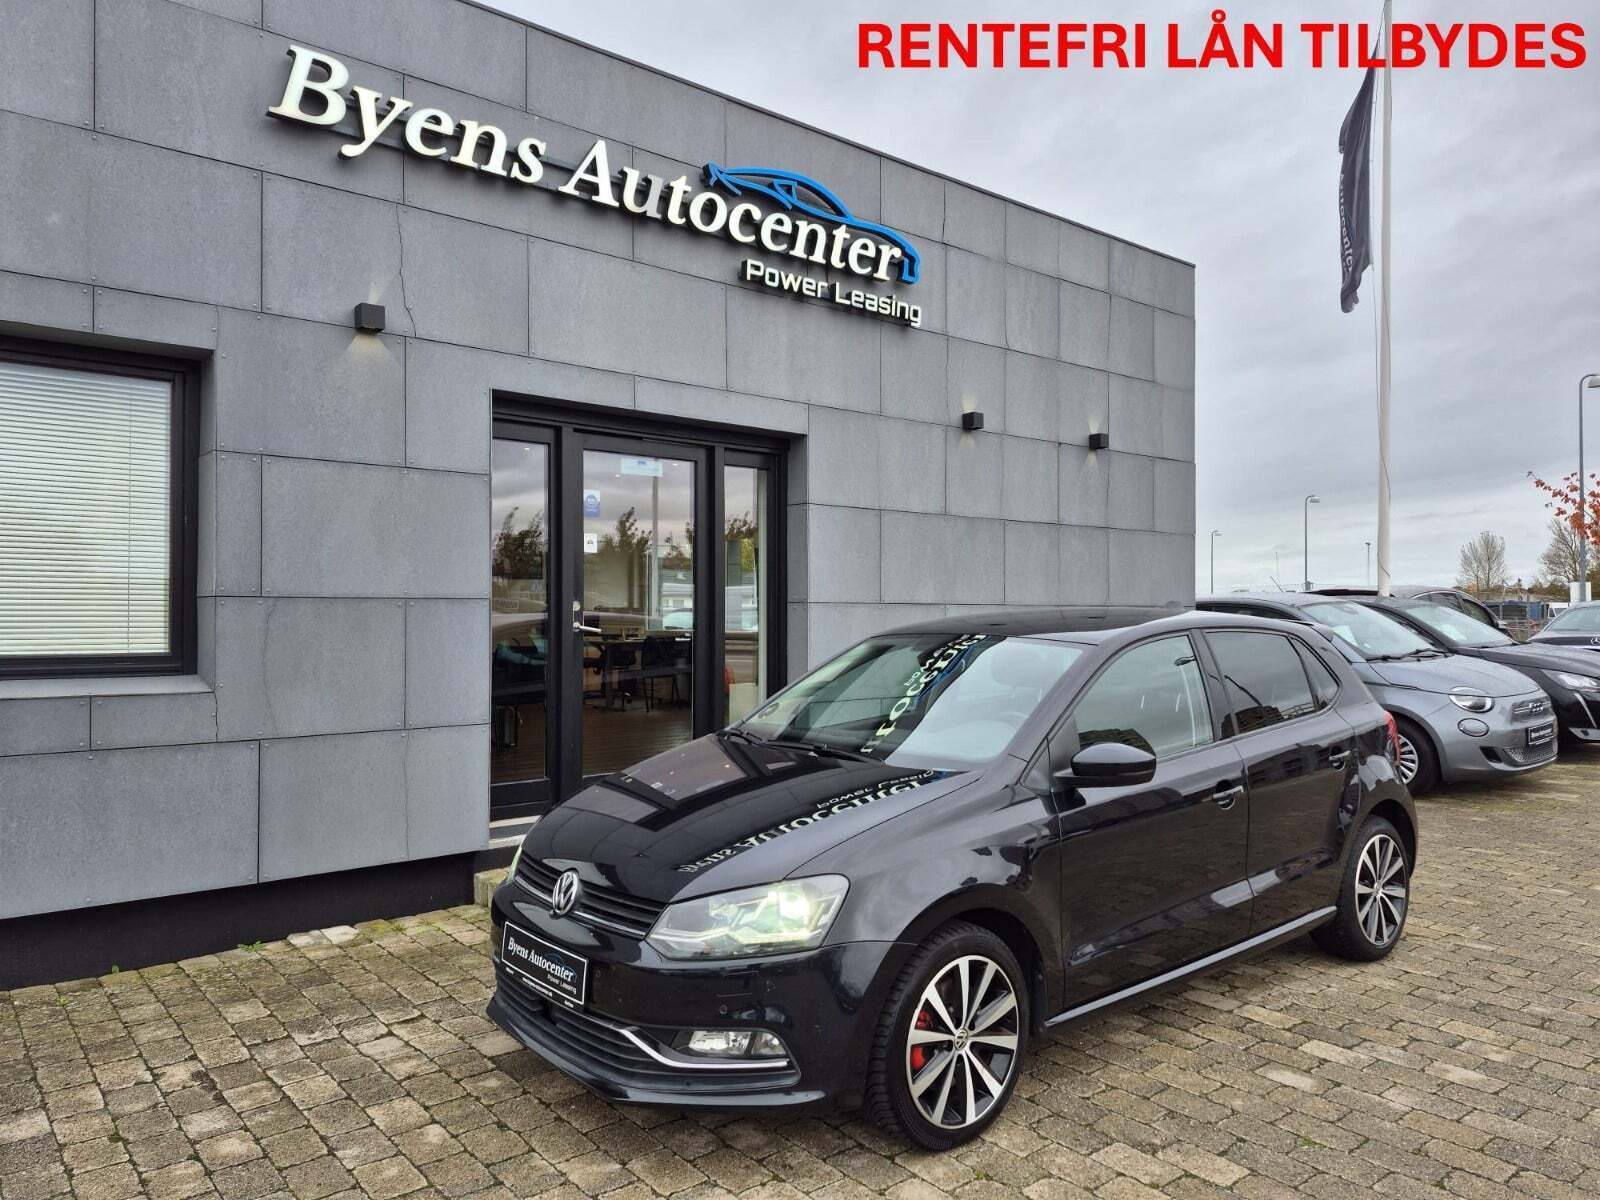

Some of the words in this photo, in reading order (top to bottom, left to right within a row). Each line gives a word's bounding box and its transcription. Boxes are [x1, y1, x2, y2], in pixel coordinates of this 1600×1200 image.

[267, 44, 547, 184] Byens
[558, 139, 902, 282] Autocenter
[745, 258, 829, 298] Power
[835, 281, 922, 328] Leasing
[508, 936, 529, 959] Byens
[527, 949, 574, 982] Autocenter
